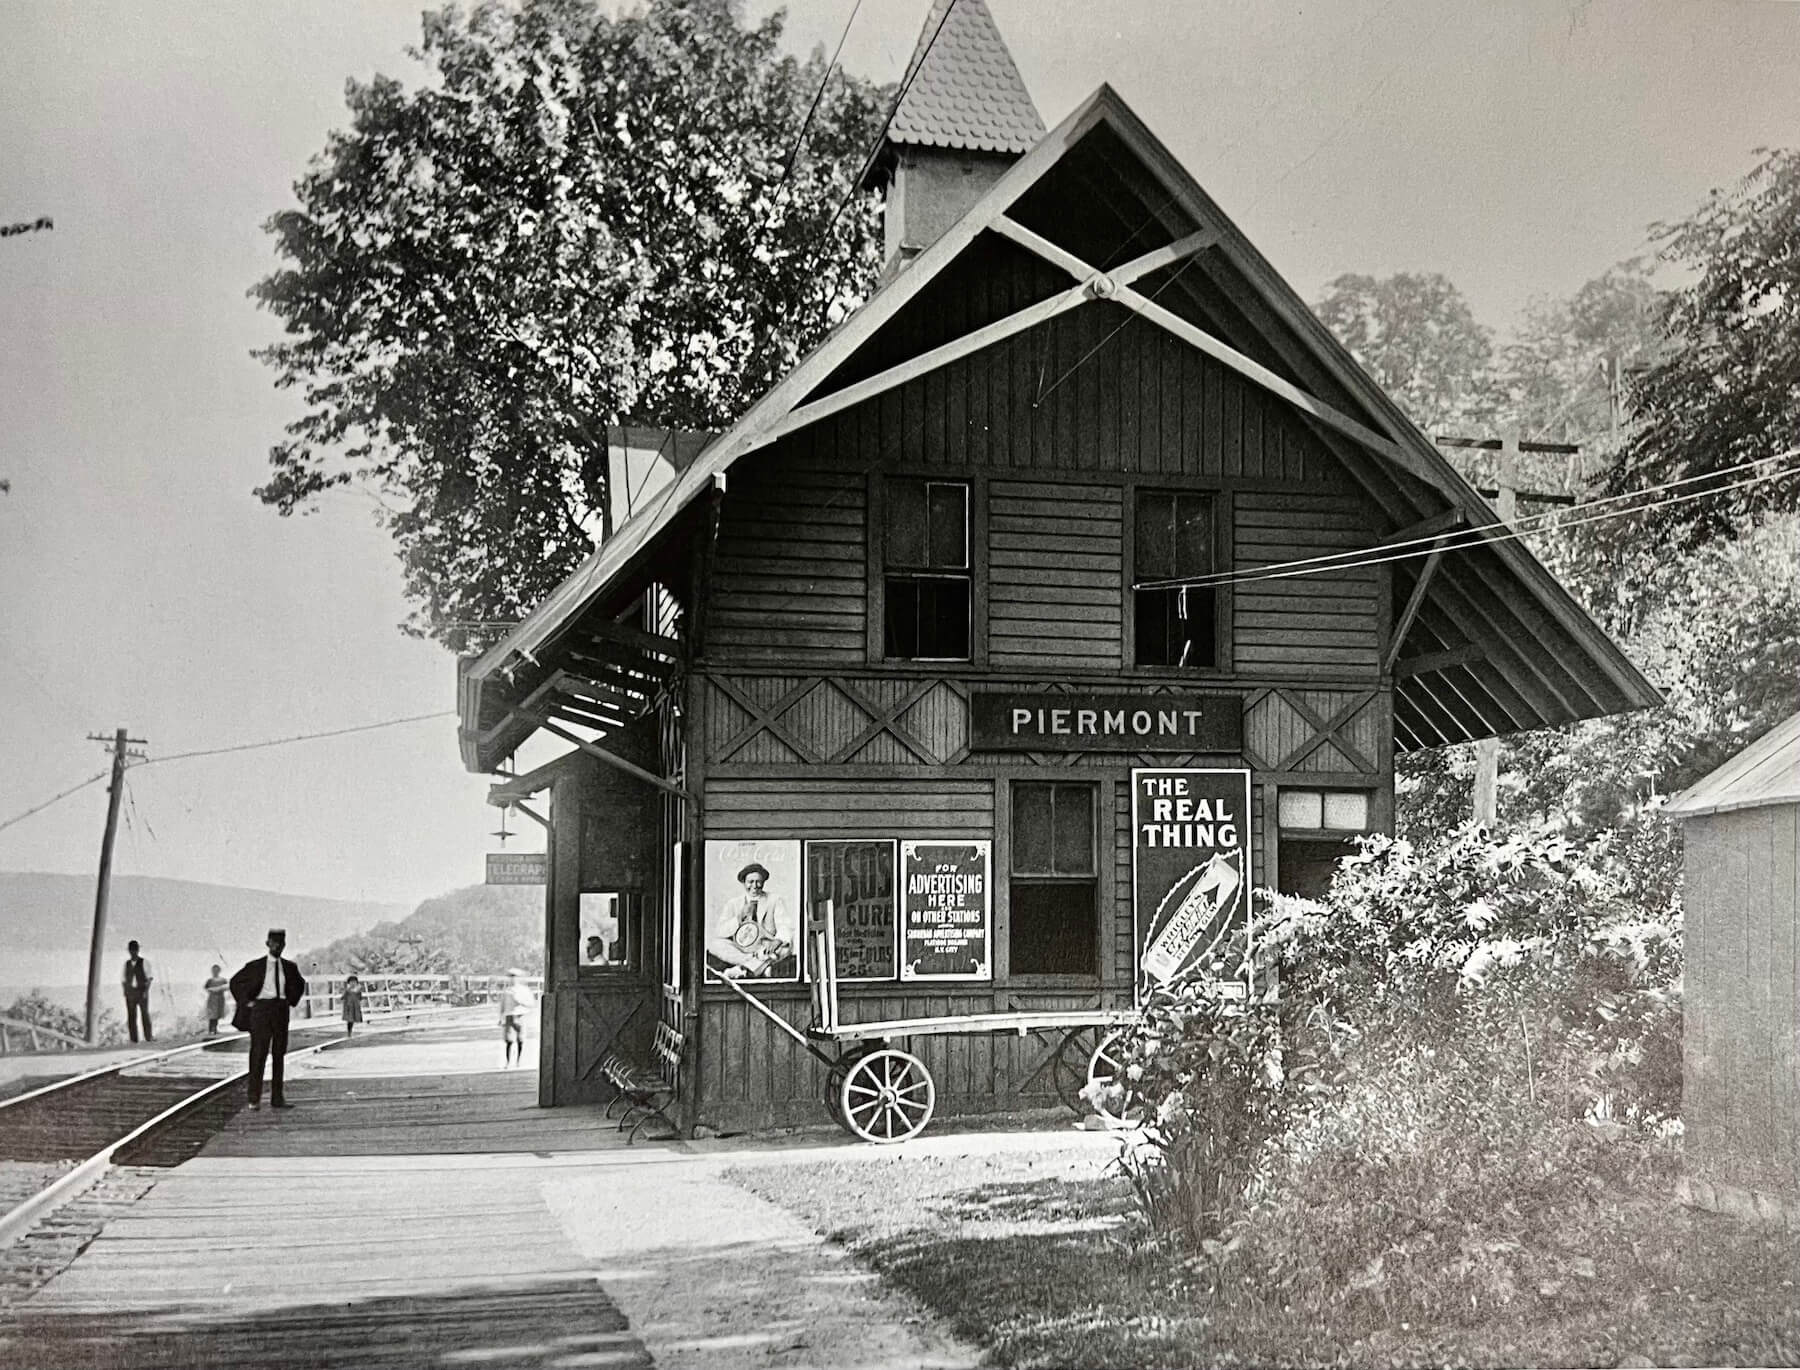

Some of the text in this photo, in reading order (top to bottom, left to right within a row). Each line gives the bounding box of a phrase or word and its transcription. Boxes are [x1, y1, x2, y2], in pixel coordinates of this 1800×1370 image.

[1012, 708, 1203, 736] PIERMONT
[1142, 778, 1189, 796] THE
[1153, 798, 1234, 822] REAL
[1141, 823, 1238, 848] THING
[935, 863, 958, 873] FOR
[908, 873, 983, 894] ADVERTISING
[928, 894, 965, 907] HERE
[846, 904, 893, 926] CURE
[911, 909, 980, 923] ON OTHER STATIONS
